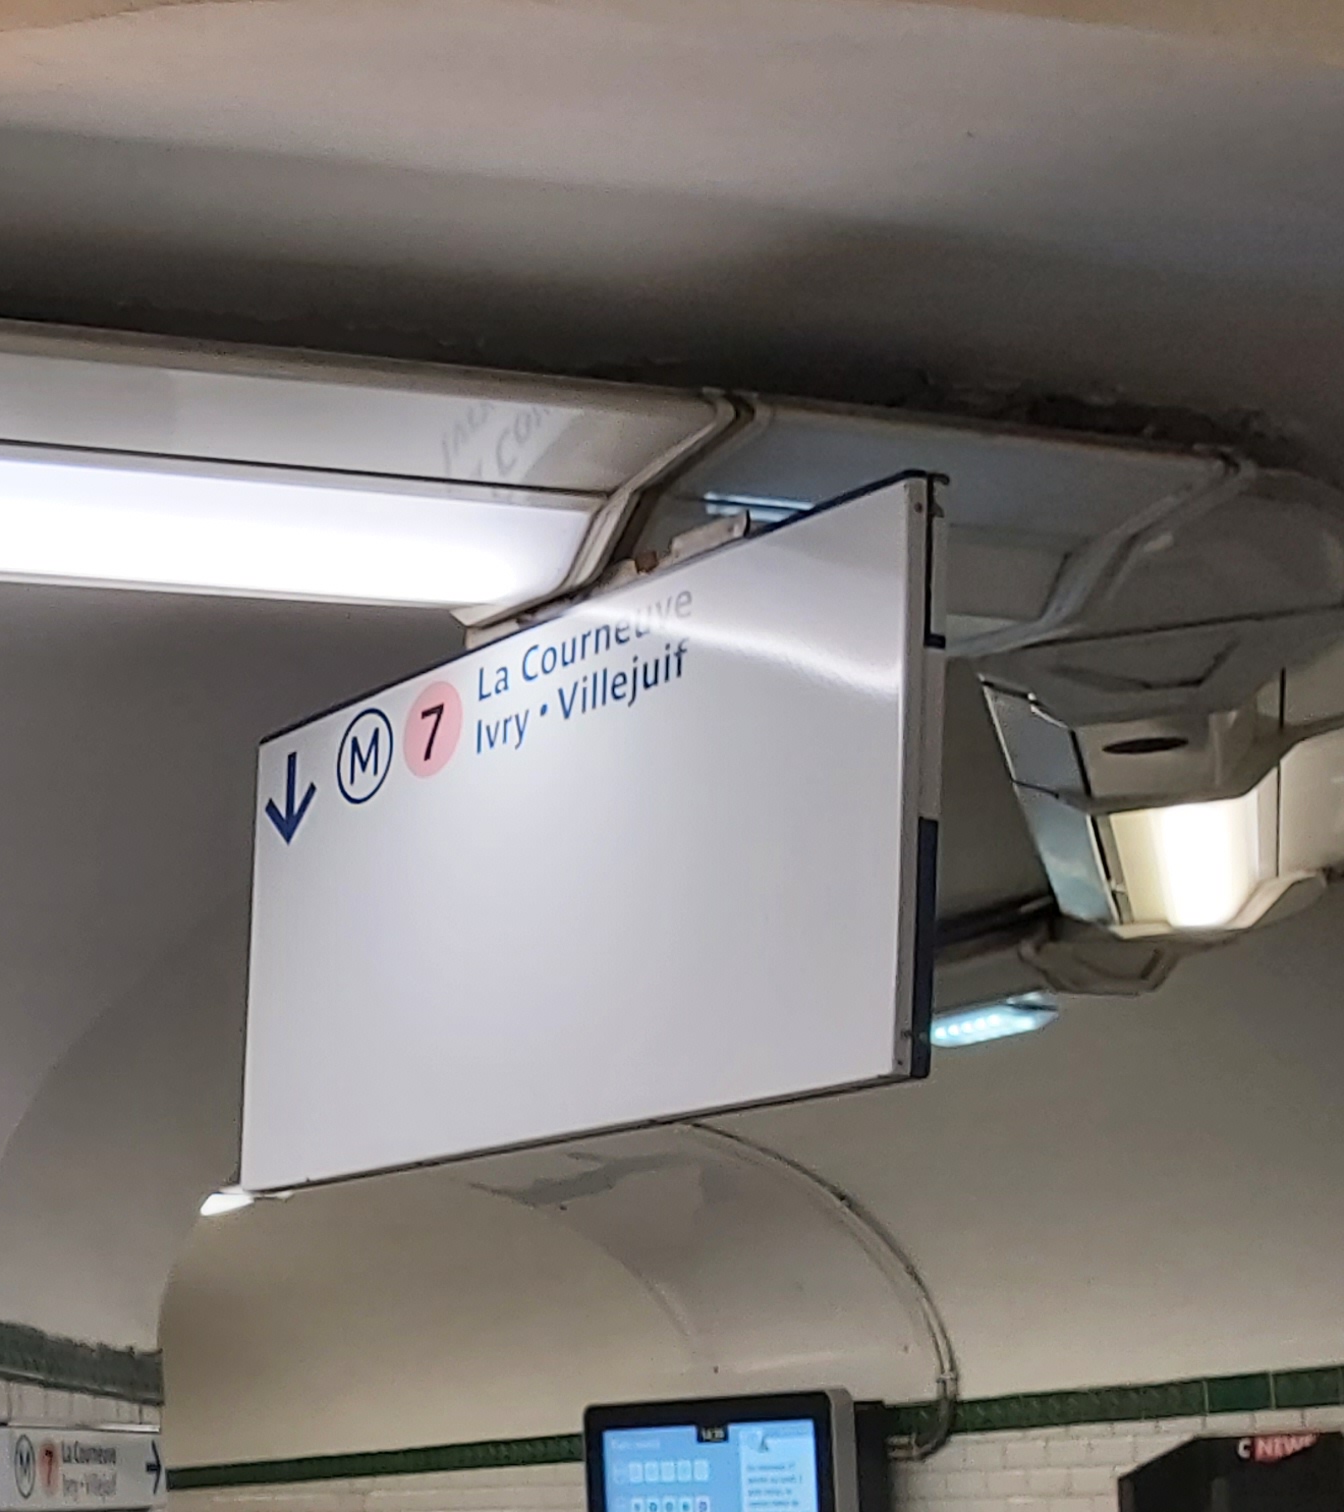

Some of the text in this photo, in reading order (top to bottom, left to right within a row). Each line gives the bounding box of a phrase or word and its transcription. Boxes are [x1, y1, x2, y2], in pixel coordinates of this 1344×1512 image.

[476, 638, 690, 755] Ivry Villejuif
[477, 589, 693, 701] La Courneuve
[421, 703, 445, 761] 7
